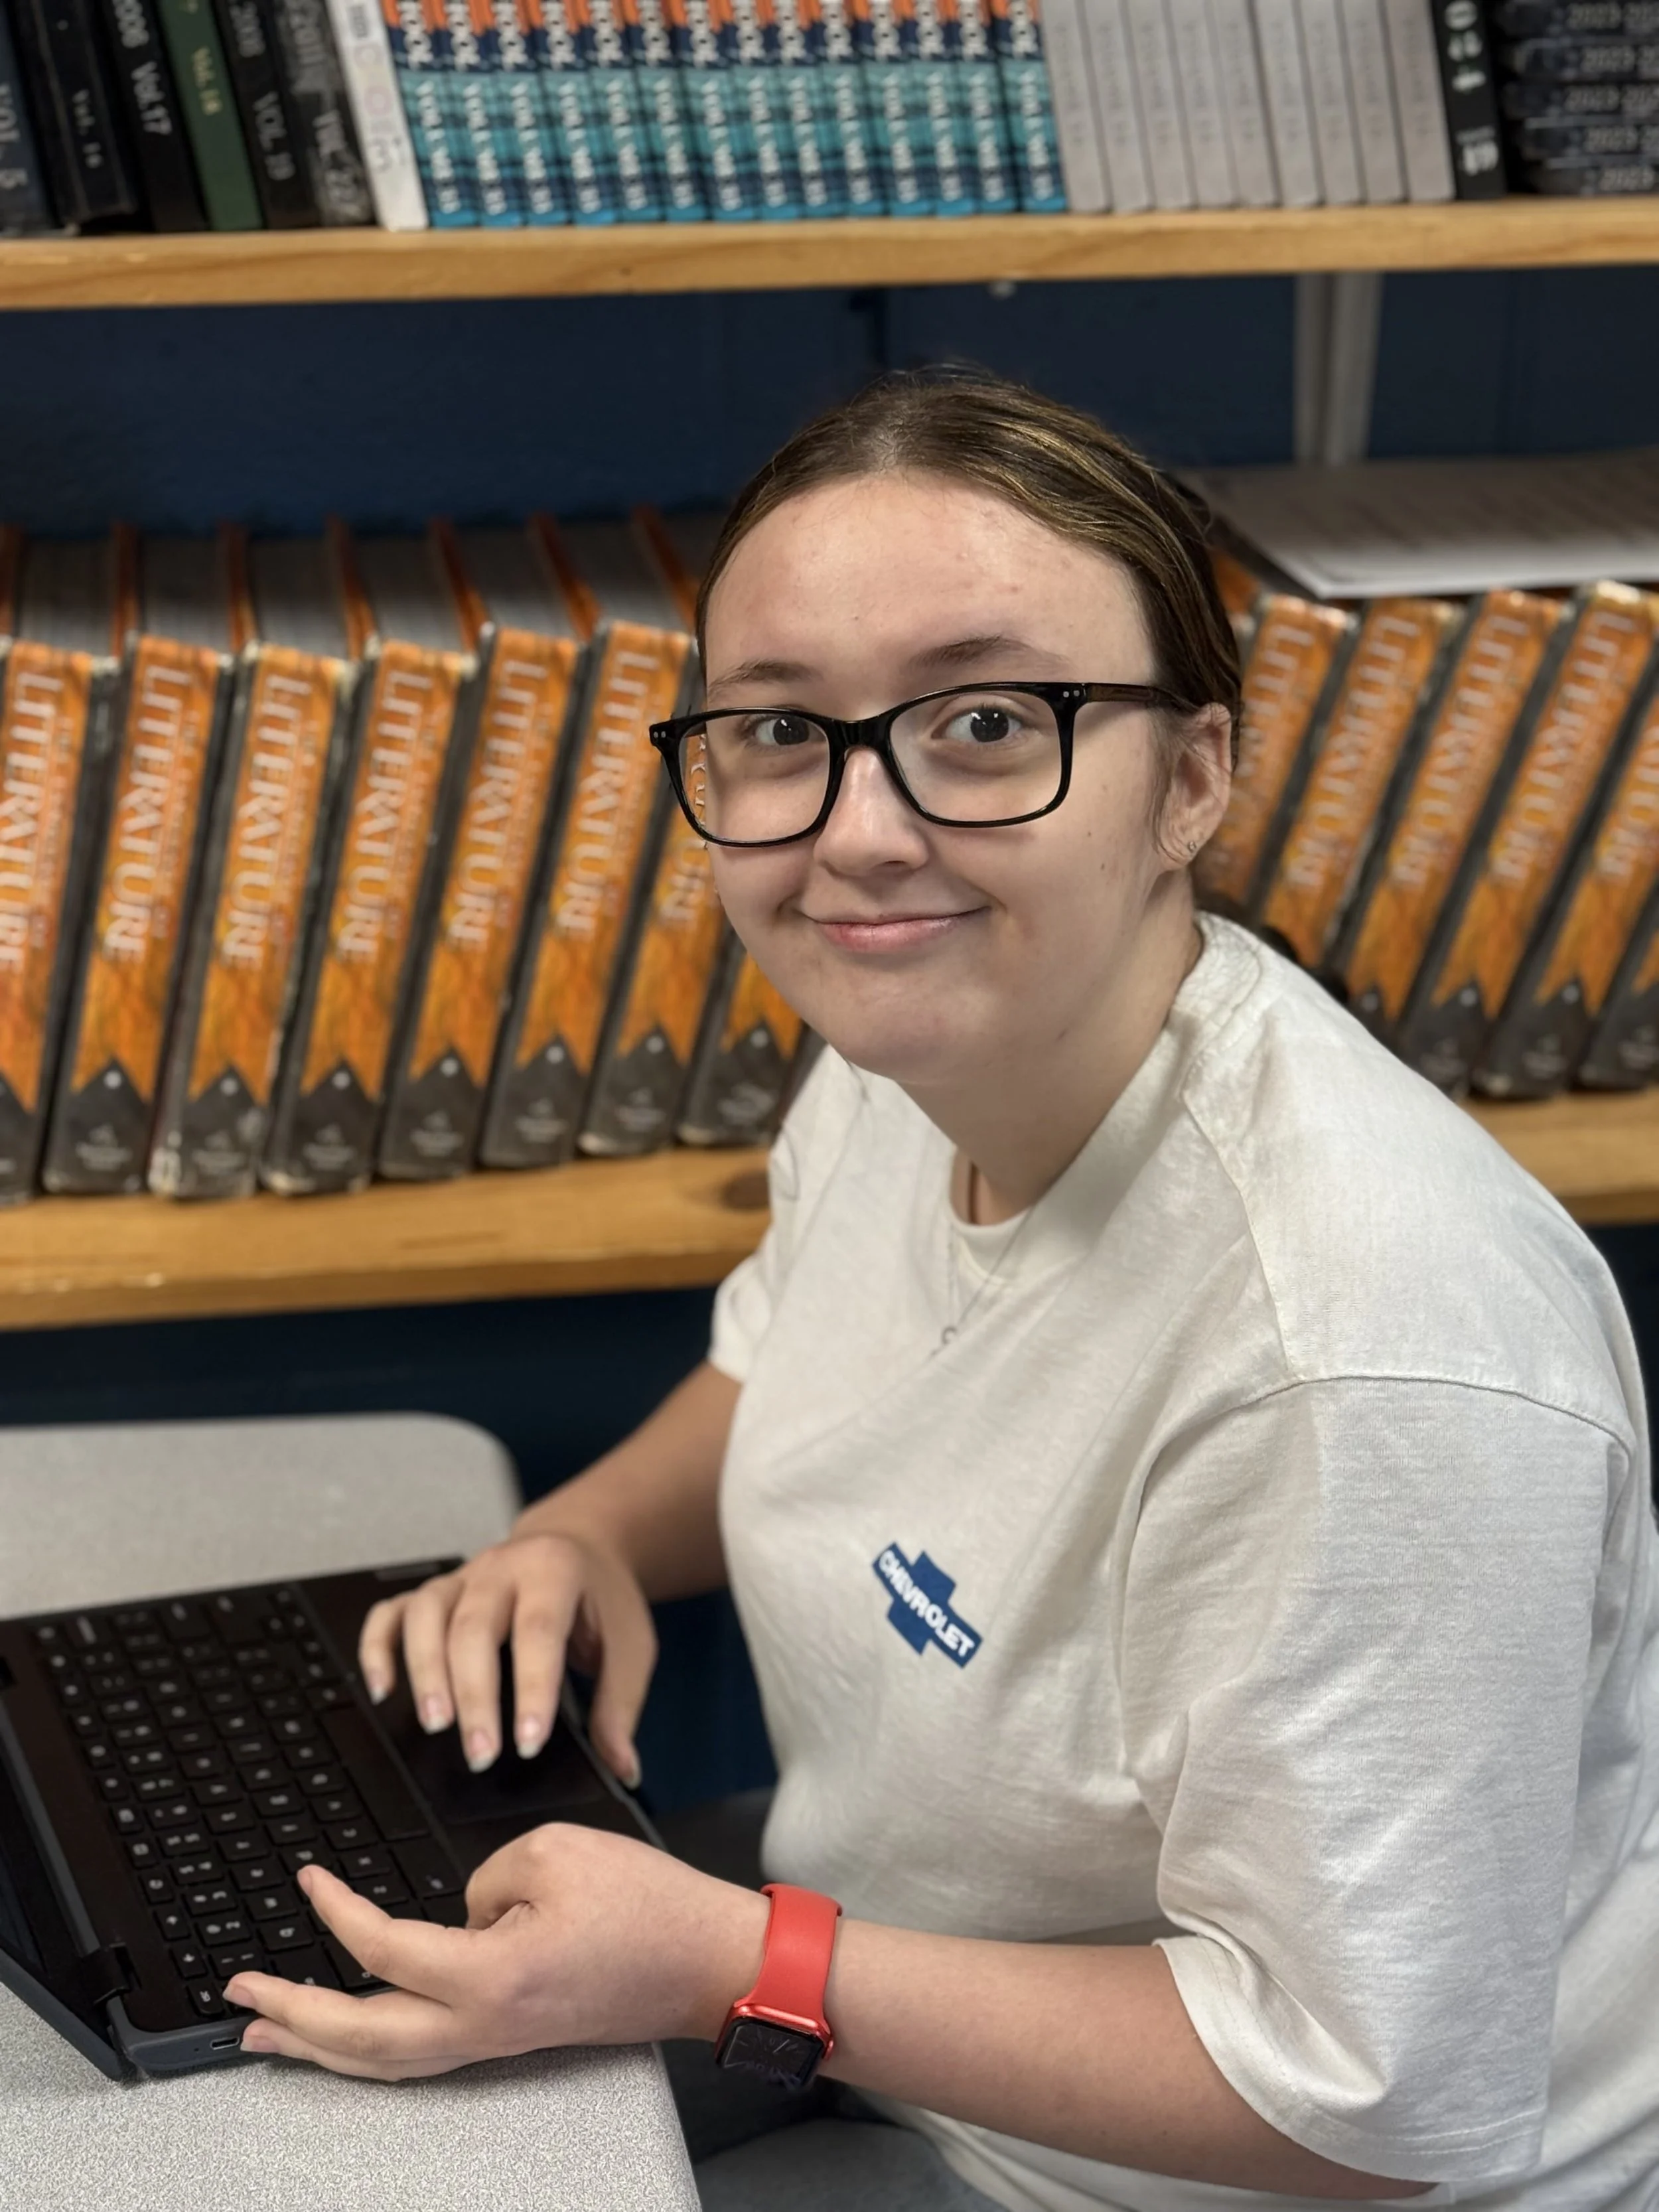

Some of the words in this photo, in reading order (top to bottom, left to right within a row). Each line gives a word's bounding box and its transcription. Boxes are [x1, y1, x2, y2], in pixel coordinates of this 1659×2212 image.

[104, 664, 191, 964] LITERATURE
[221, 672, 313, 971] LITERATURE
[338, 670, 432, 964] LITERATURE
[448, 659, 547, 951] LITERATURE
[555, 651, 660, 942] LITERATURE
[879, 1550, 975, 1657] CHEVROLET
